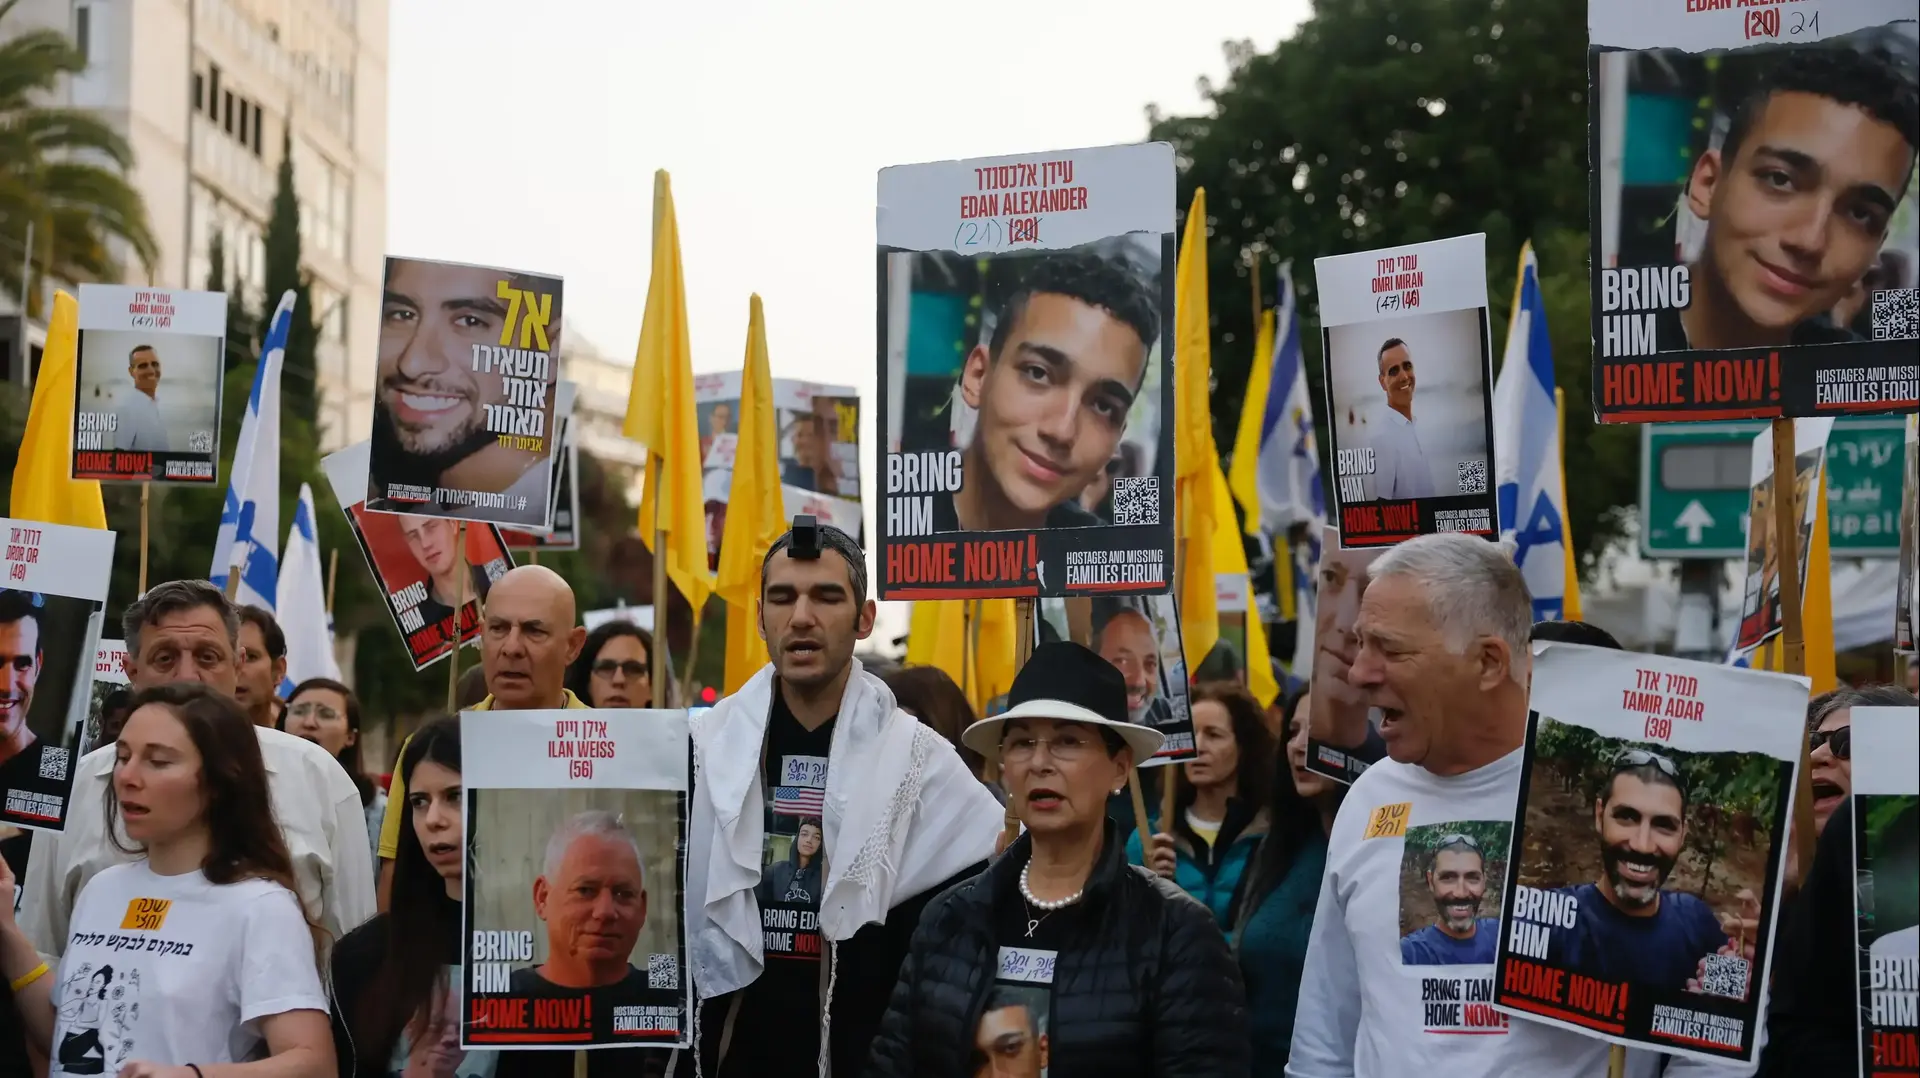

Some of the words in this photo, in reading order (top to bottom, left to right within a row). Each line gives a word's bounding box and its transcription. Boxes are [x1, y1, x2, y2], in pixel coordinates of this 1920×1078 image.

[1745, 8, 1780, 39] (20)
[1790, 11, 1819, 37] 21
[975, 163, 1037, 190] אלכסנדר
[1042, 160, 1073, 187] עידן
[960, 194, 998, 219] EDAN
[1002, 187, 1088, 216] ALEXANDER
[955, 219, 1002, 249] (21)
[1009, 217, 1039, 245] (20)
[1377, 258, 1395, 277] מירן
[1397, 254, 1417, 271] עמרי
[1372, 276, 1393, 293] OMRI
[1396, 271, 1423, 290] MIRAN
[1602, 265, 1690, 312] BRING
[1377, 294, 1400, 313] (47)
[1402, 289, 1420, 309] (46)
[497, 280, 552, 351] אל
[1603, 313, 1657, 357] HIM
[472, 344, 549, 379] תשאירו
[1816, 368, 1865, 383] HOSTAGES
[1867, 367, 1886, 381] AND
[1888, 365, 1919, 380] MISSI
[1603, 362, 1685, 407] HOME
[1693, 352, 1781, 402] NOW!
[1816, 382, 1878, 404] FAMILIES
[1882, 380, 1919, 401] FORU
[503, 378, 547, 408] אותי
[78, 411, 117, 431] BRING
[483, 404, 544, 437] מאחור
[77, 432, 102, 450] HIM
[497, 435, 512, 449] דוד
[516, 437, 542, 452] אביתר
[77, 452, 112, 472] HOME
[116, 452, 152, 472] NOW!
[887, 451, 962, 493] BRING
[1338, 447, 1376, 475] BRING
[1340, 477, 1366, 503] HIM
[887, 496, 933, 536] HIM
[1344, 506, 1381, 533] HOME
[1381, 500, 1419, 531] NOW!
[1436, 519, 1465, 532] FAMILIES
[1466, 518, 1490, 531] FORUM
[24, 529, 42, 545] דרור
[6, 545, 25, 561] DROR
[27, 547, 38, 563] OR
[887, 543, 957, 584] HOME
[963, 534, 1037, 583] NOW!
[1066, 551, 1107, 565] HOSTAGES
[1108, 550, 1125, 564] AND
[1127, 549, 1163, 563] MISSING
[10, 562, 26, 581] (48)
[1066, 564, 1118, 584] FAMILIES
[1121, 563, 1163, 583] FORUM
[391, 580, 428, 614] BRING
[399, 606, 426, 635] HIM
[408, 623, 444, 655] HOME
[1636, 669, 1661, 691] אדר
[1665, 673, 1698, 697] תמיר
[1623, 689, 1662, 715] TAMIR
[1665, 697, 1704, 721] ADAR
[556, 721, 578, 738] וייס
[582, 720, 607, 740] אילן
[1645, 715, 1672, 741] (38)
[548, 741, 573, 758] ILAN
[577, 741, 615, 758] WEISS
[569, 760, 593, 780] (56)
[812, 763, 829, 776] נה
[5, 797, 37, 815] FAMILIES
[37, 803, 61, 819] FORUM
[763, 908, 798, 929] BRING
[800, 910, 821, 930] EDA
[1513, 884, 1577, 929] BRING
[71, 932, 105, 945] סליח
[106, 934, 145, 952] לבקש
[146, 938, 194, 956] במקום
[473, 930, 533, 961] BRING
[763, 932, 793, 951] HOME
[1508, 920, 1550, 960] HIM
[472, 963, 511, 993] HIM
[1870, 955, 1919, 989] BRI
[1422, 978, 1461, 1001] BRING
[1504, 958, 1564, 1004] HOME
[1567, 973, 1629, 1020] NOW!
[472, 999, 528, 1029] HOME
[534, 995, 591, 1029] NOW!
[613, 1006, 645, 1016] HOSTAGES
[646, 1006, 657, 1016] AND
[1424, 1003, 1461, 1026] HOME
[1653, 1004, 1693, 1021] HOSTAGES
[1693, 1011, 1709, 1024] AND
[1710, 1014, 1744, 1031] MISSING
[1871, 990, 1919, 1027] HIM
[614, 1016, 654, 1031] FAMILIES
[654, 1016, 679, 1031] FORU
[1652, 1015, 1700, 1040] FAMILIES
[1702, 1024, 1742, 1048] FORUM
[1873, 1031, 1919, 1067] HOM
